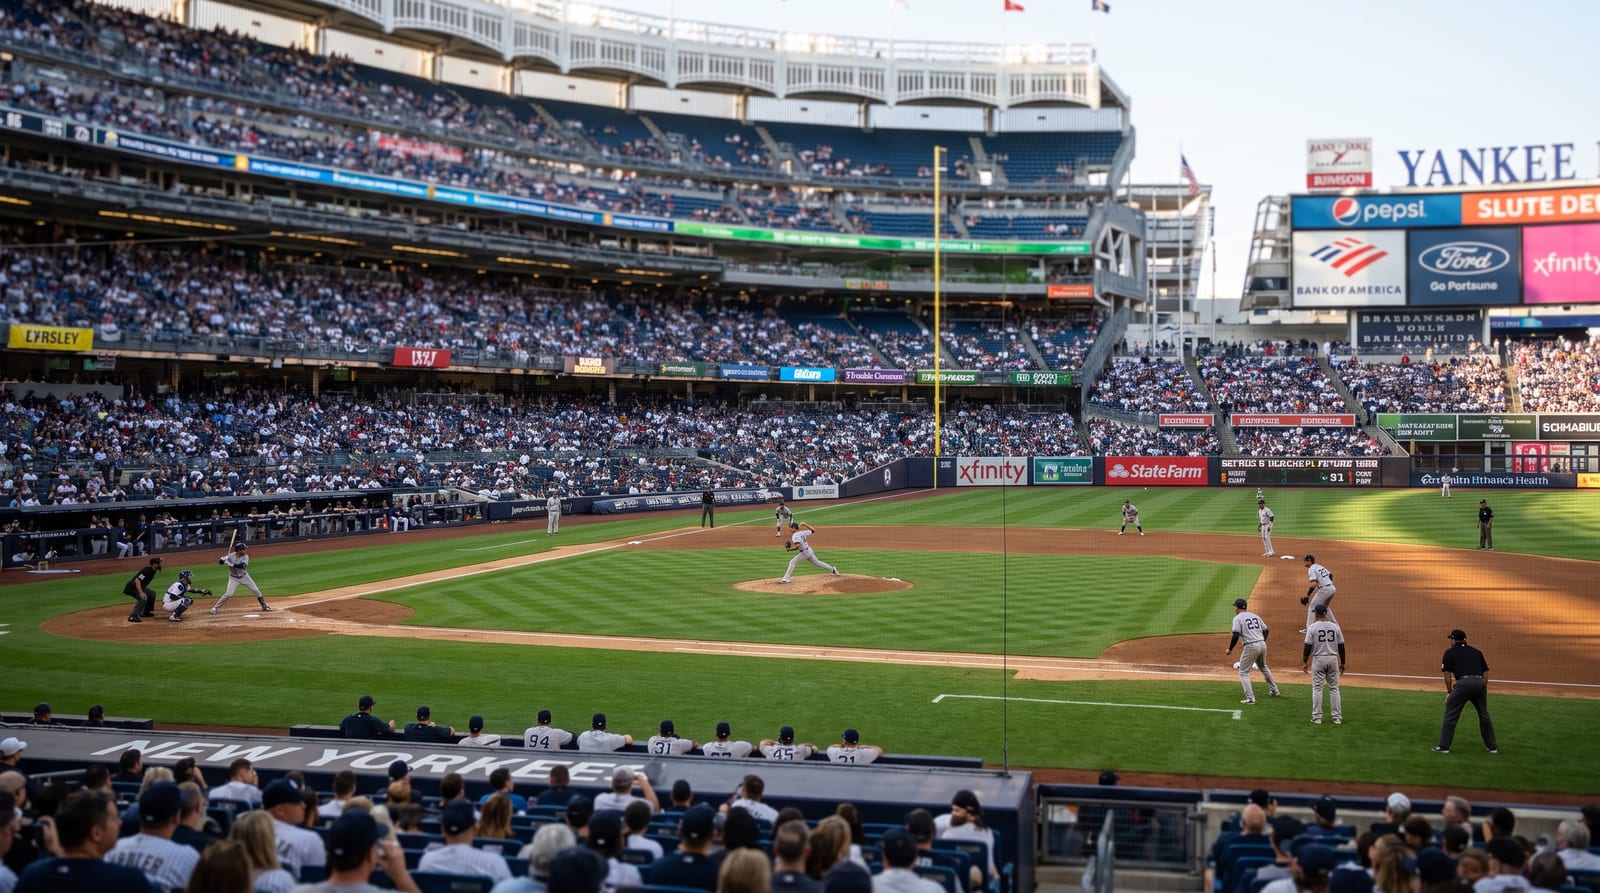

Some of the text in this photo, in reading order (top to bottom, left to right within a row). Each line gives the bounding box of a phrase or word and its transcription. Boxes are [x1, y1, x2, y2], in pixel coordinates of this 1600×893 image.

[1398, 142, 1577, 187] YANKEE
[1364, 200, 1425, 222] pepsi
[1478, 195, 1555, 218] SLUTE
[1435, 246, 1493, 270] Ford
[1533, 251, 1600, 278] xfinity
[1296, 285, 1402, 295] BANK OF AMERICA
[1430, 281, 1446, 291] Go
[959, 459, 1026, 484] xfinity
[1245, 617, 1261, 630] 23
[1317, 629, 1336, 643] 23
[529, 734, 550, 749] 94
[654, 741, 672, 755] 31
[90, 739, 304, 763] NEW
[773, 748, 794, 761] 45
